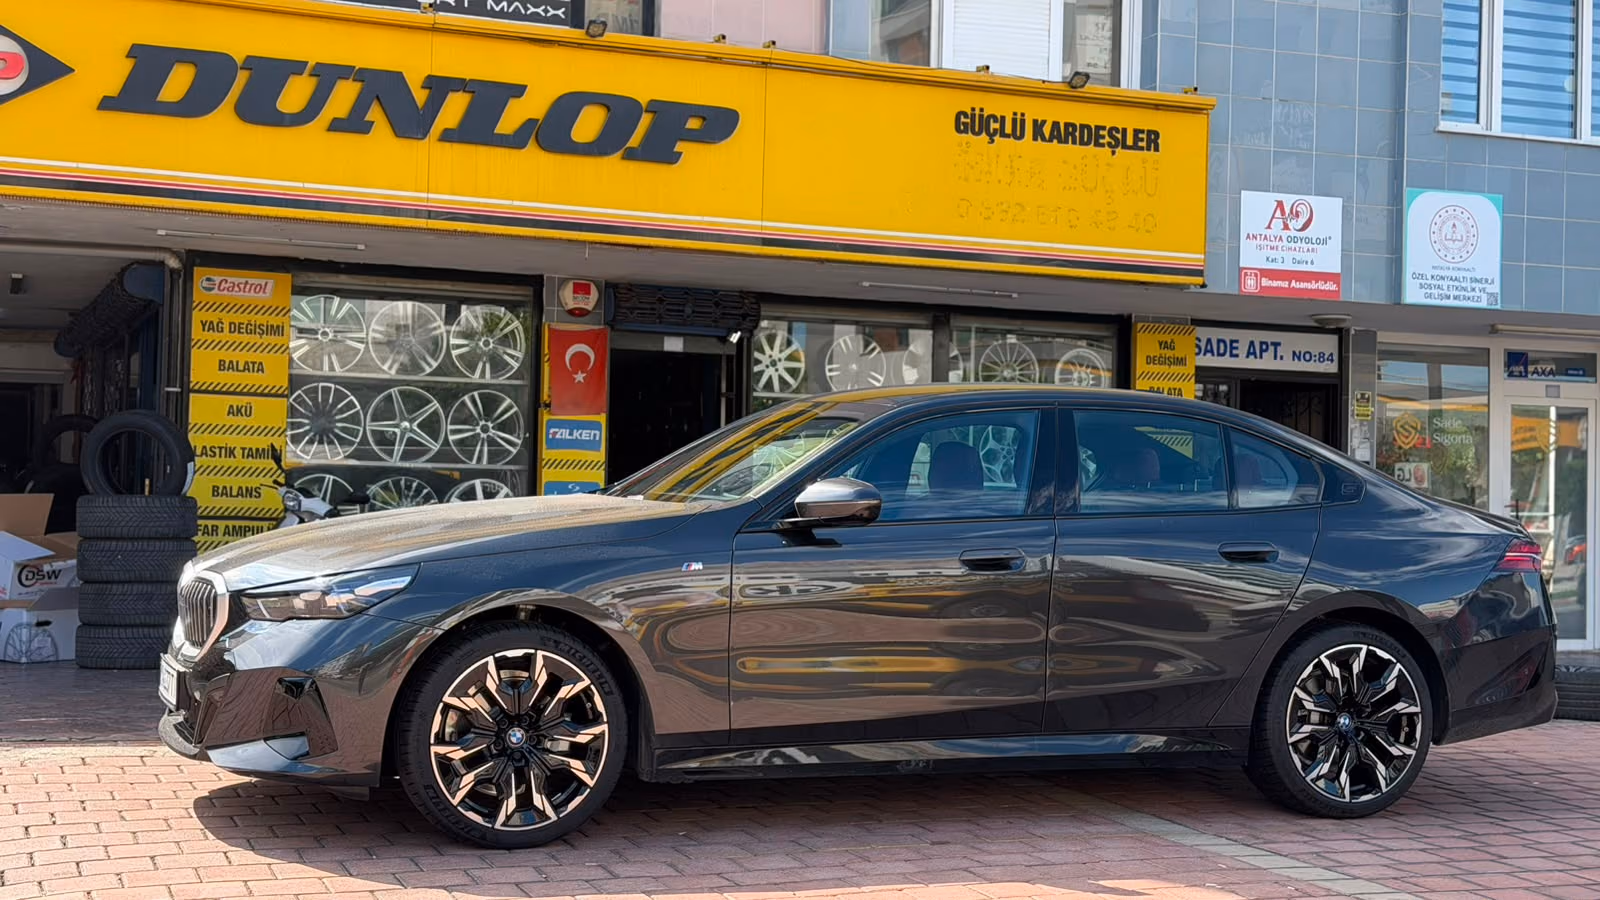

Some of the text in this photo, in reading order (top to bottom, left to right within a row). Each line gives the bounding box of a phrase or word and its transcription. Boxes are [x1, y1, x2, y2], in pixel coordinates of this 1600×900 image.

[97, 43, 740, 165] DUNLOP
[954, 107, 1160, 156] GÜÇLÜ KARDEŞLER
[1246, 233, 1284, 243] ANTALYA
[1411, 272, 1429, 280] ÖZEL
[1431, 273, 1468, 283] KONYAALTI
[217, 279, 268, 294] Castrol
[1419, 282, 1445, 291] SOSYAL
[200, 317, 285, 339] YAĞ DEĞİŞİMİ
[1145, 339, 1187, 369] YAĞ DEĞİŞİMİ
[1195, 336, 1335, 364] SADE APT. NO:84
[218, 359, 265, 374] BALATA
[1531, 366, 1556, 378] AXA
[227, 402, 253, 417] AKÜ
[1432, 416, 1463, 429] Sade
[549, 428, 600, 440] FALKEN
[1432, 432, 1473, 446] Sigorta
[193, 443, 283, 460] LASTİK TAMİİ
[211, 485, 262, 499] BALANS
[25, 570, 62, 581] DSW
